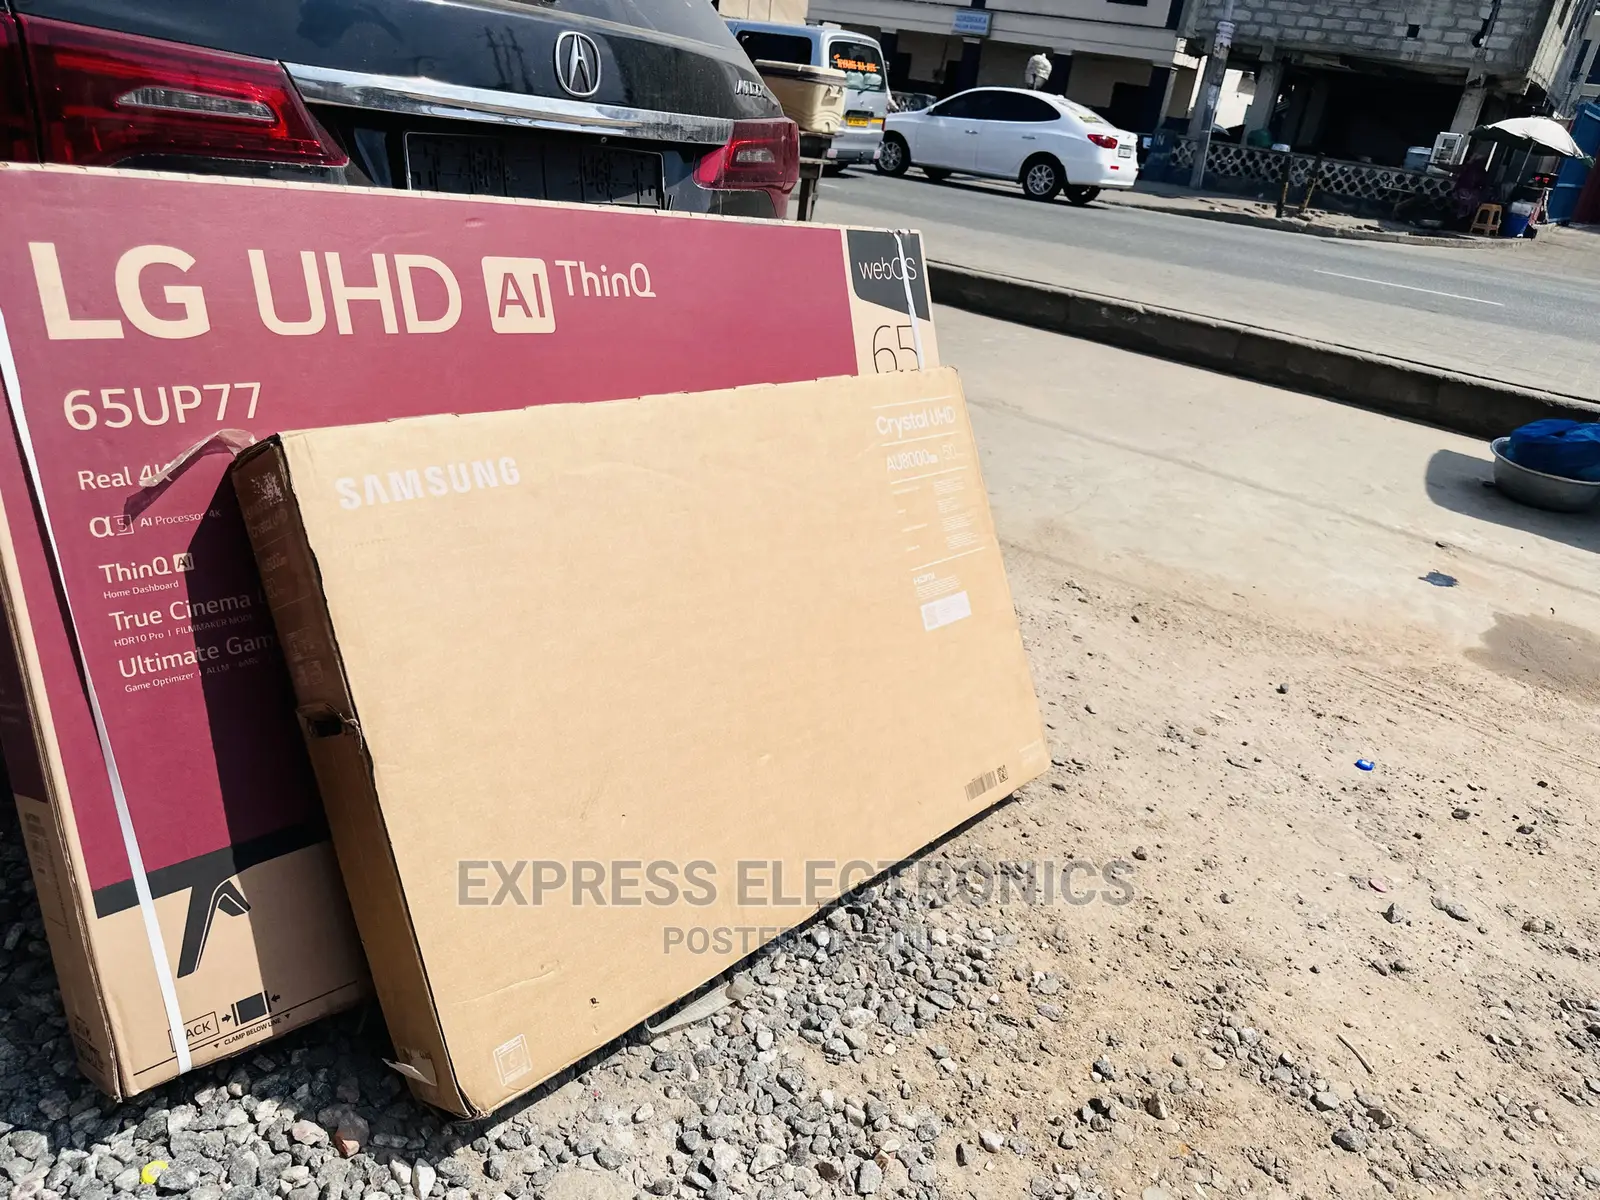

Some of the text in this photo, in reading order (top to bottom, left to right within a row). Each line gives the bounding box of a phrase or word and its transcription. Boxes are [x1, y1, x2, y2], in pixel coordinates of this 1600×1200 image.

[858, 257, 917, 280] webOS
[28, 242, 210, 339] LG
[248, 249, 462, 336] UHD
[555, 260, 657, 297] ThinQ
[63, 382, 262, 431] 65UP77
[875, 406, 956, 438] Crystal UHD
[887, 449, 930, 474] AU8000
[77, 467, 133, 490] Real
[335, 457, 520, 510] SAMSUNG
[140, 518, 153, 528] AI
[155, 512, 204, 525] Processor
[98, 554, 194, 584] ThinQ AI
[103, 580, 179, 599] Home Dashboard
[108, 610, 163, 632] True
[169, 594, 252, 621] Cinema
[113, 634, 147, 648] HDR10
[149, 632, 164, 641] Pro
[118, 645, 219, 678] Ultimate
[125, 681, 151, 693] Game
[152, 672, 194, 688] Optimizer
[186, 1021, 212, 1040] ACK
[224, 1017, 283, 1046] CLAMP BELOW LINE
